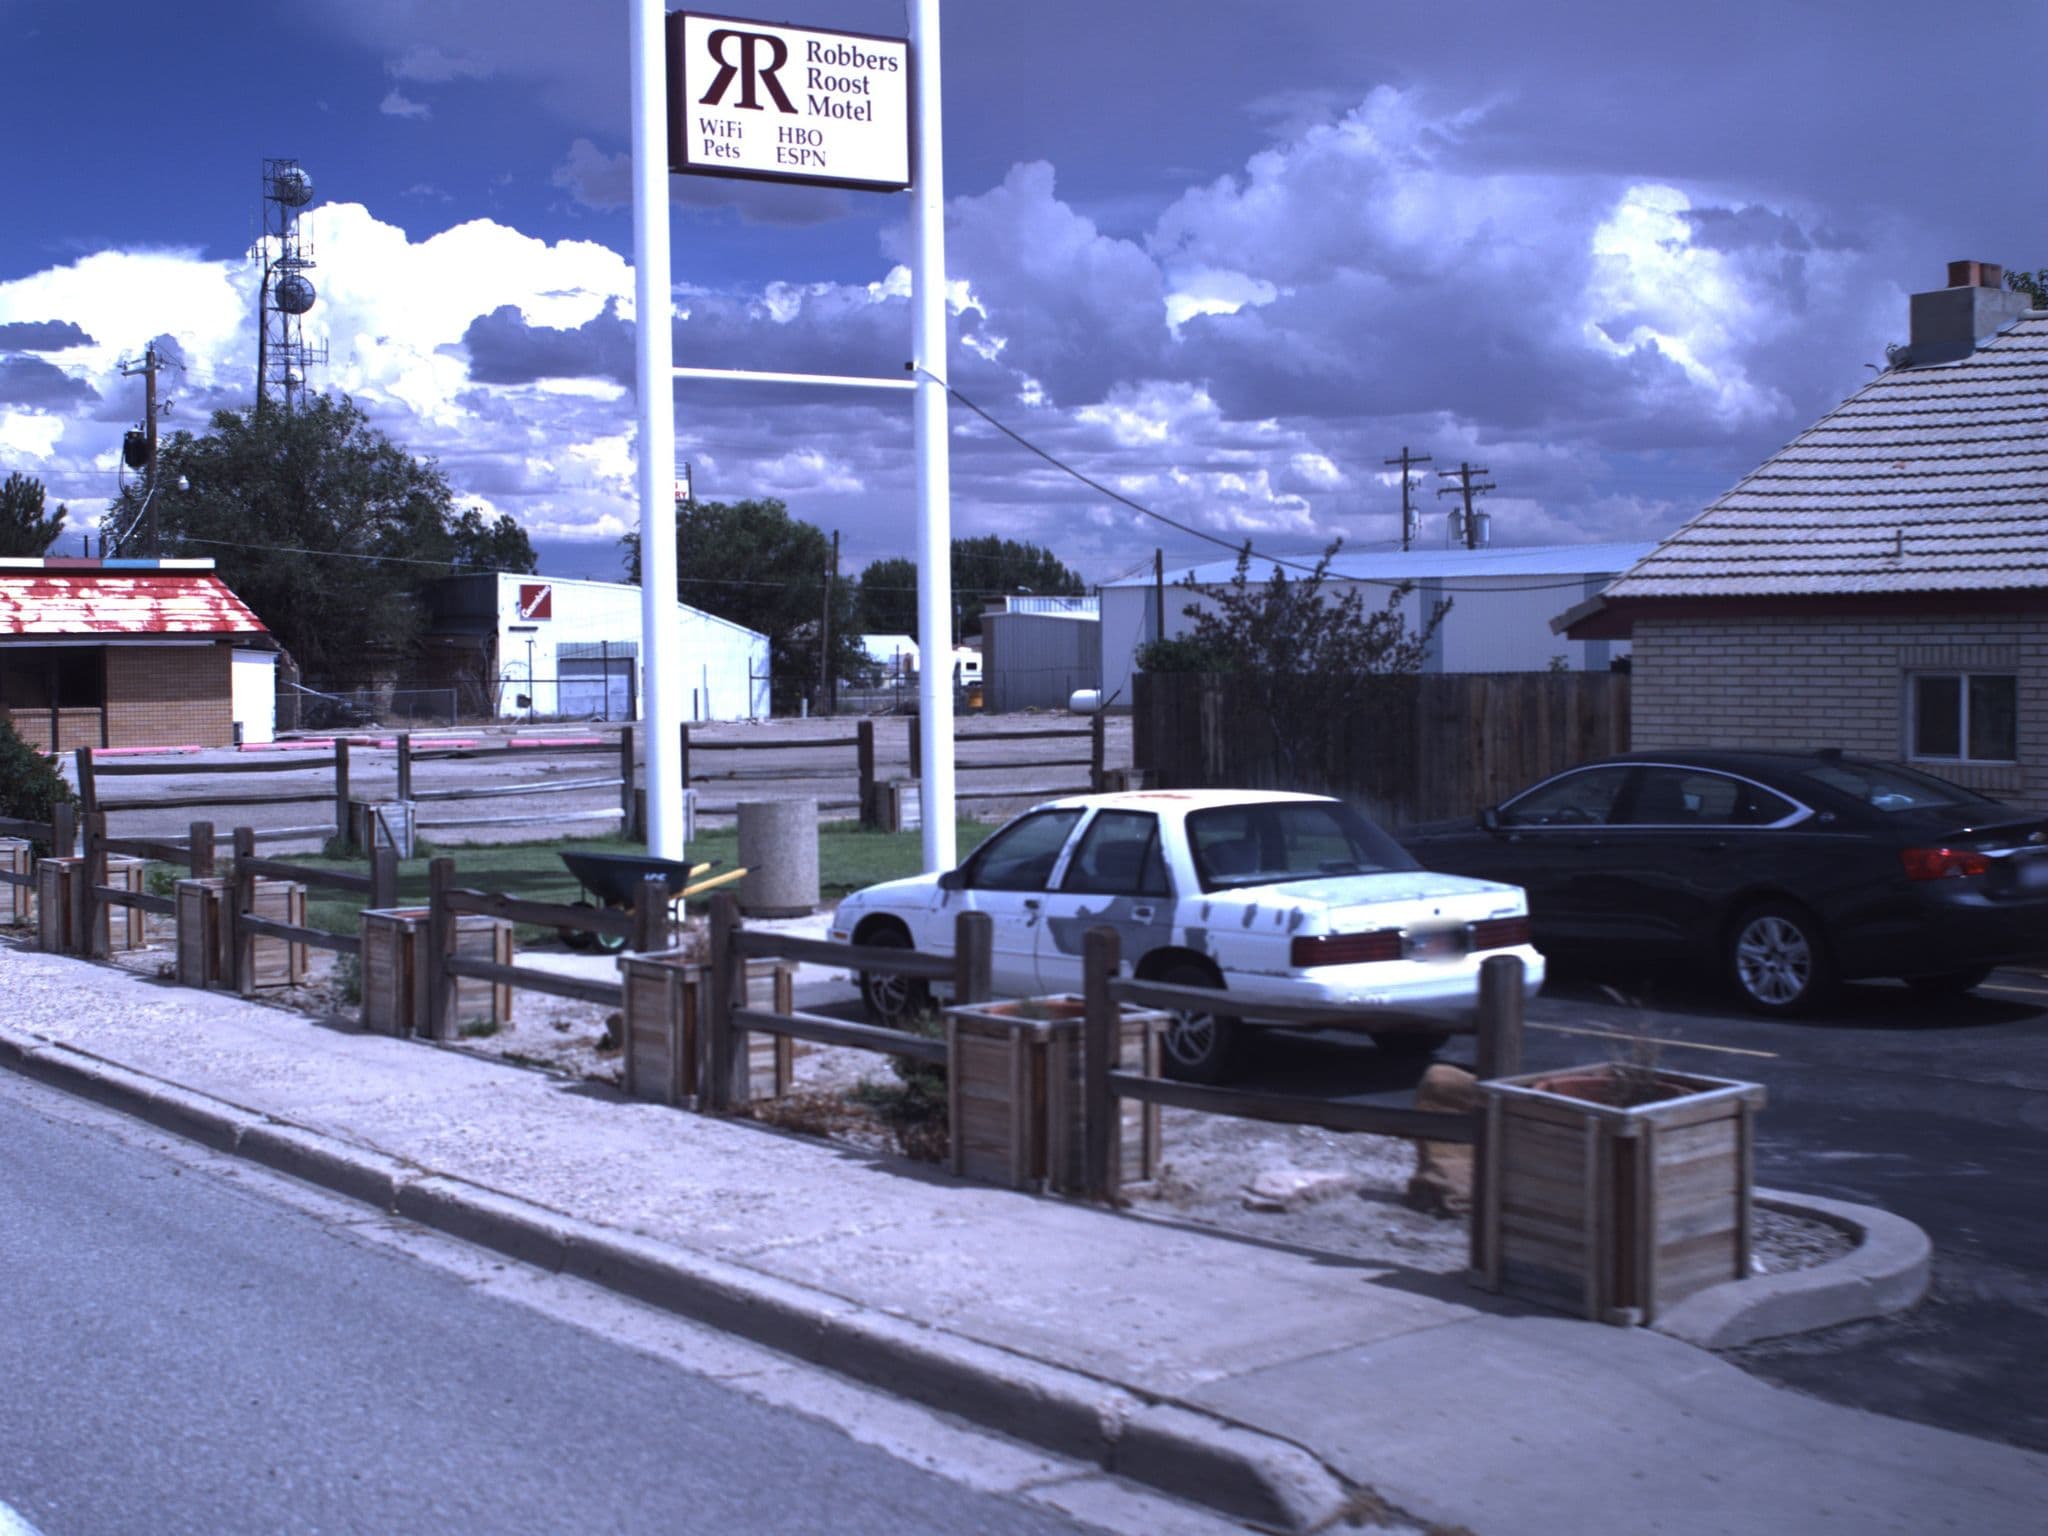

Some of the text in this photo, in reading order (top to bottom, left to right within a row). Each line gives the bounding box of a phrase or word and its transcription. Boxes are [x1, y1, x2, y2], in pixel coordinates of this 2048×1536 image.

[807, 41, 898, 72] Robbers
[807, 68, 870, 95] Roost
[807, 95, 873, 121] Motel
[700, 118, 743, 138] WiFi
[778, 127, 823, 146] HBO
[704, 139, 741, 158] Pets
[776, 147, 826, 167] ESPN
